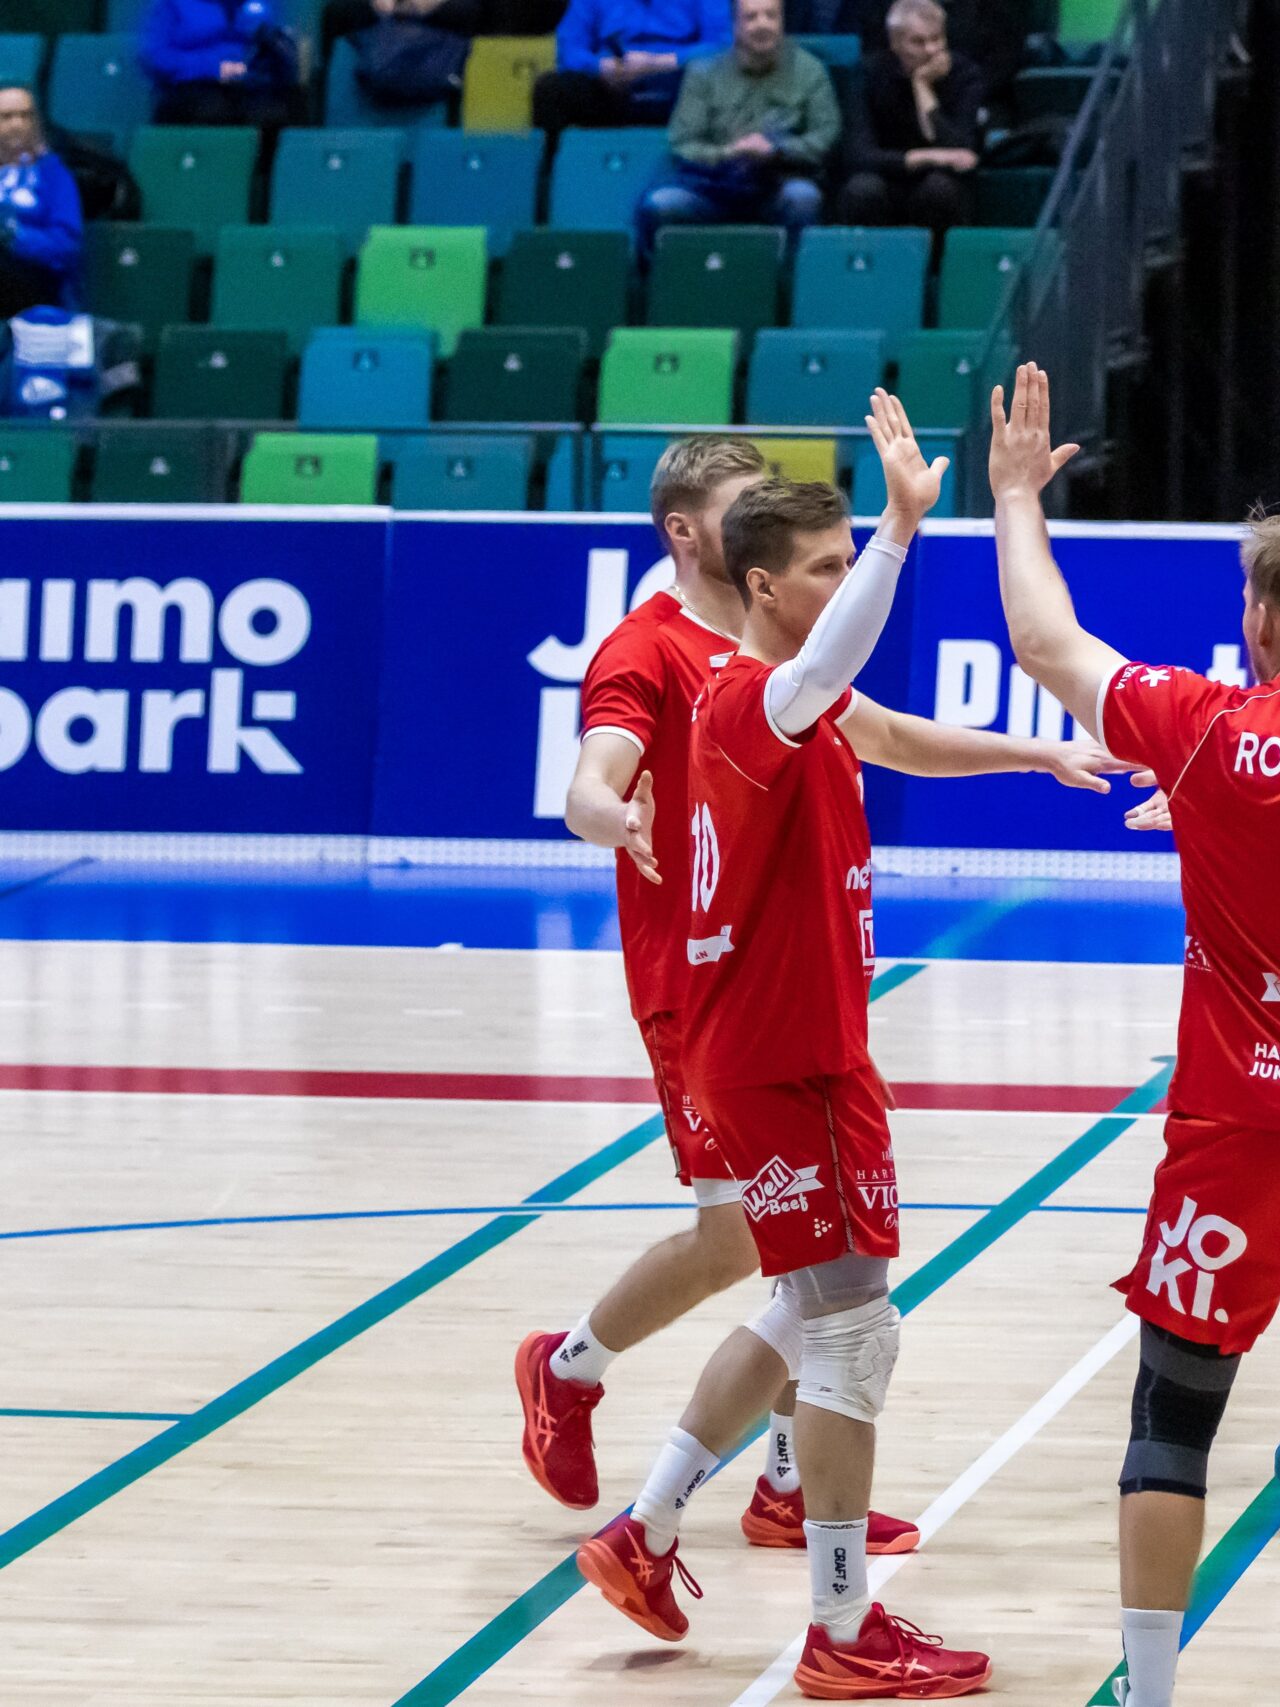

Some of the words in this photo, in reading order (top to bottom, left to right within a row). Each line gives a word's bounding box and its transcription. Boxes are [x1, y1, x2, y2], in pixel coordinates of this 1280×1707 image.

[690, 801, 720, 913] 10
[742, 1162, 788, 1214] Well
[766, 1192, 809, 1215] Beef
[1159, 1195, 1248, 1271] JO
[777, 1433, 789, 1465] CRAFT
[834, 1547, 847, 1580] CRAFT
